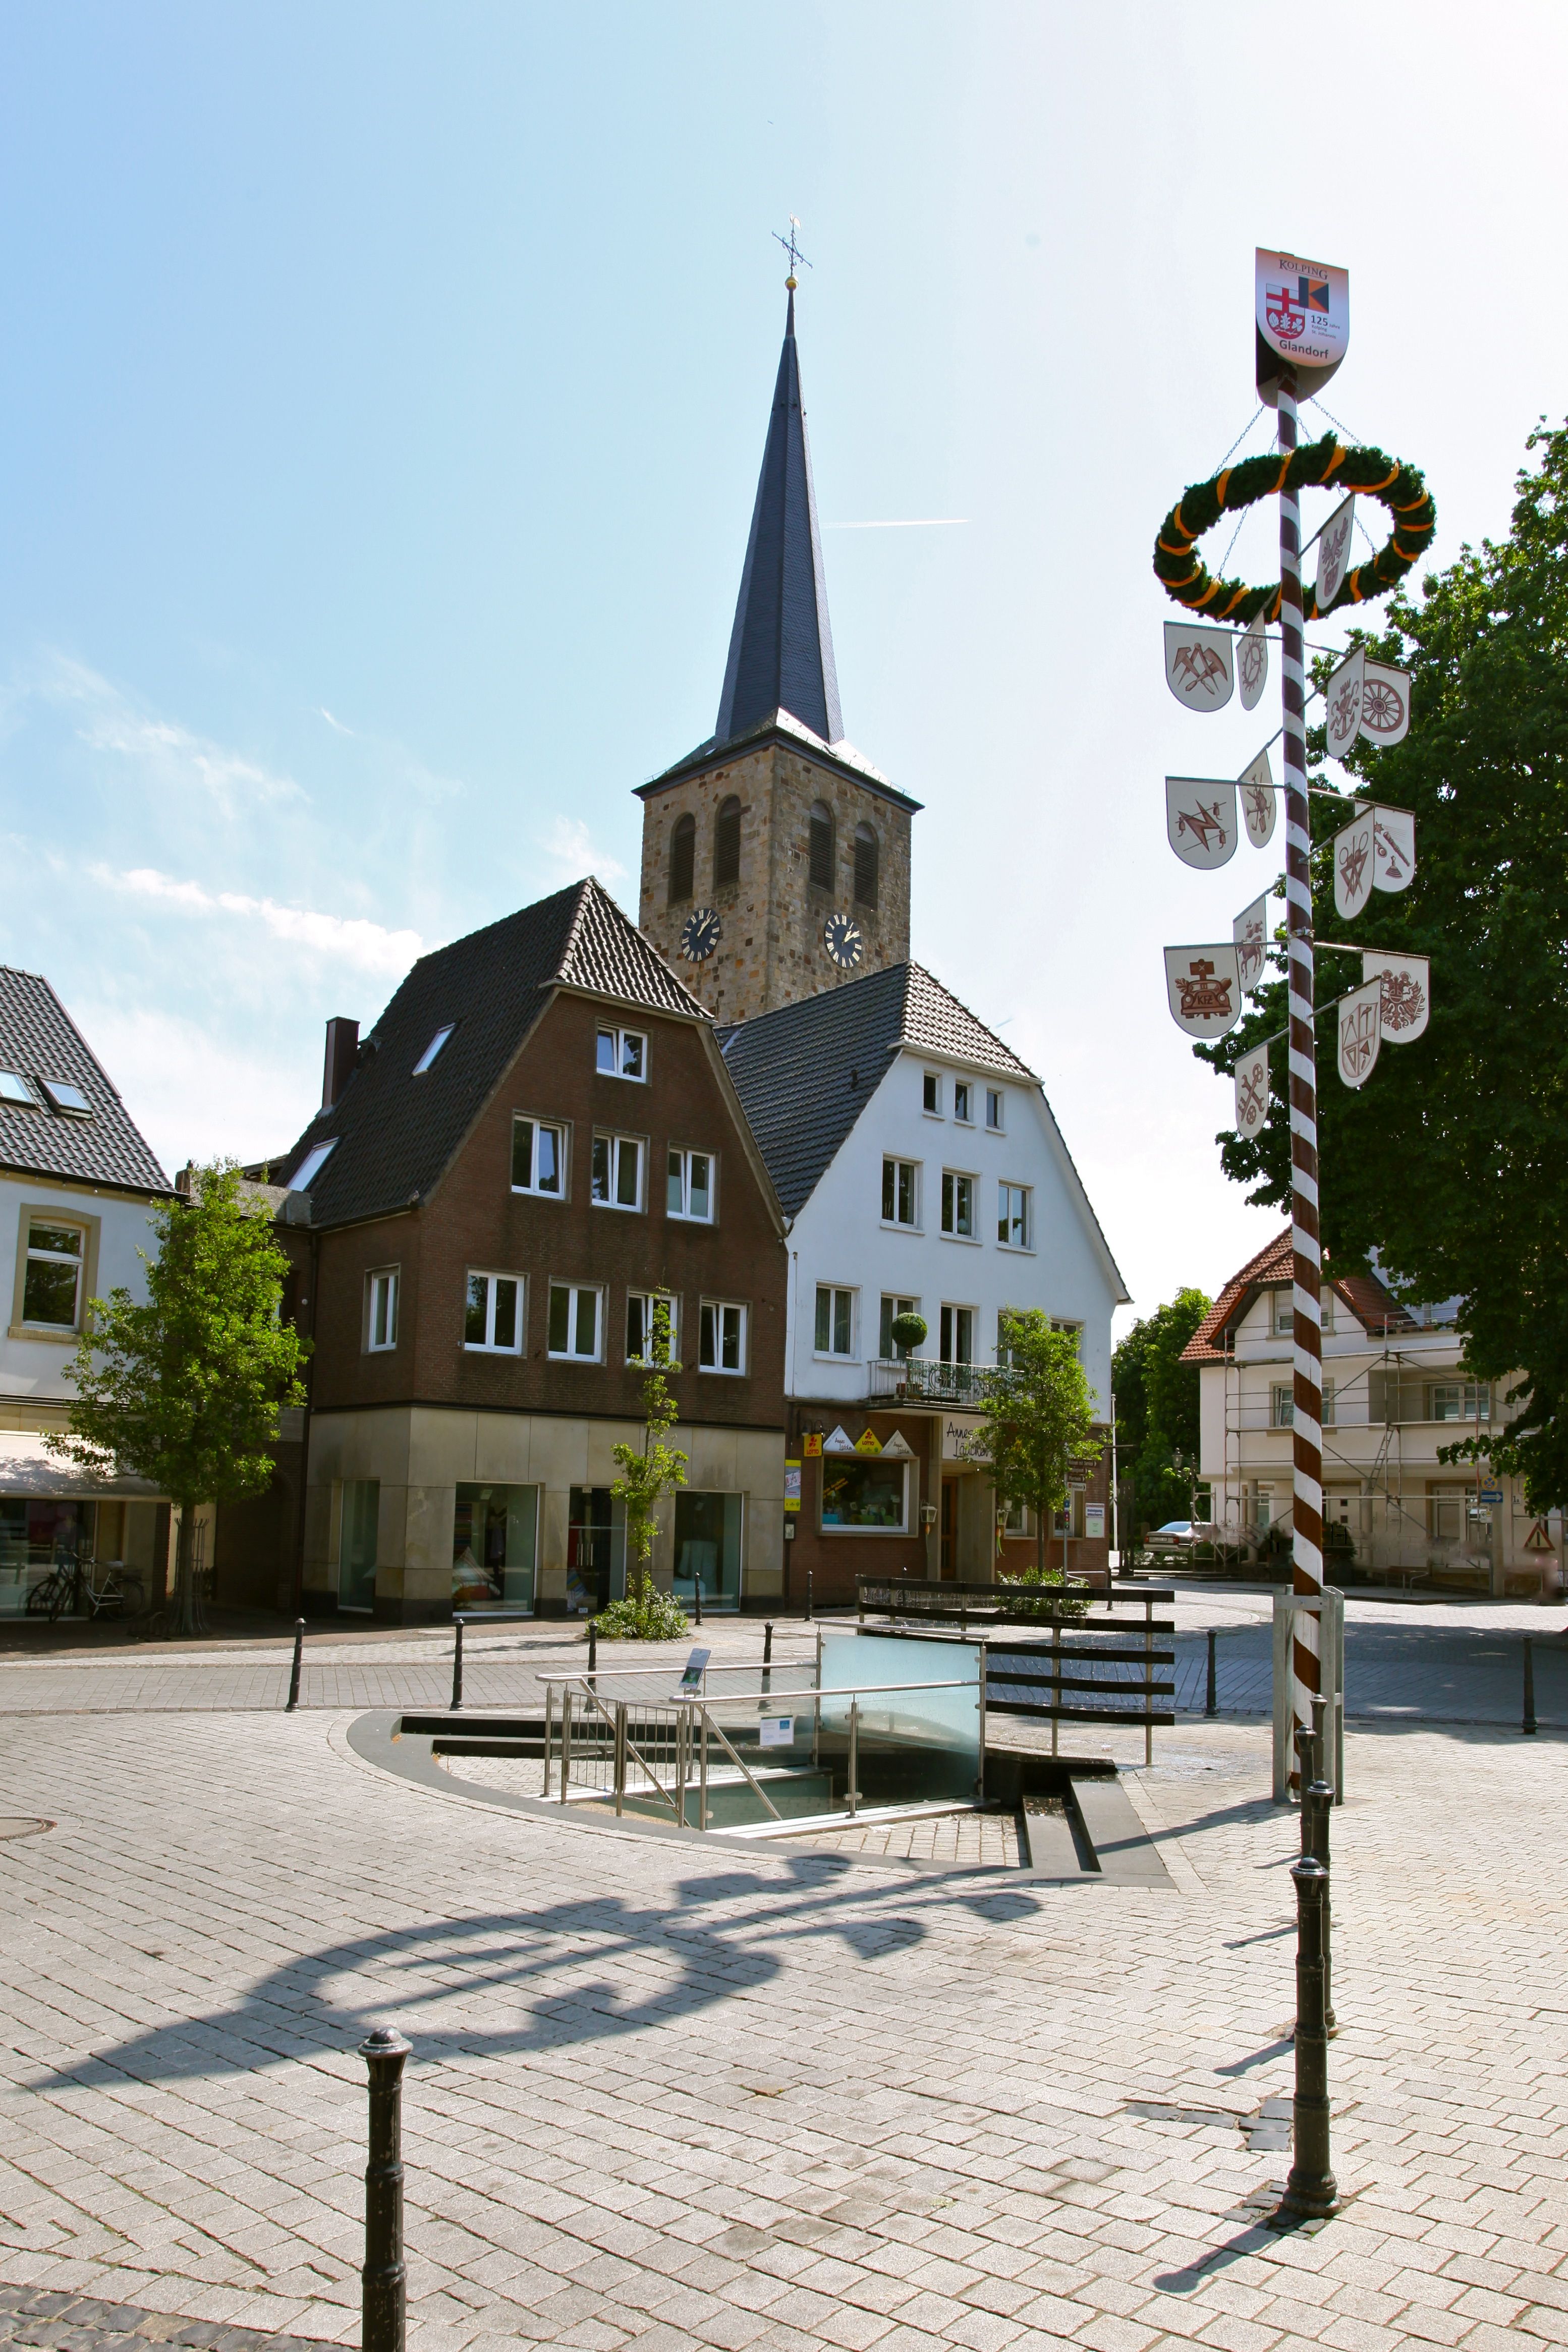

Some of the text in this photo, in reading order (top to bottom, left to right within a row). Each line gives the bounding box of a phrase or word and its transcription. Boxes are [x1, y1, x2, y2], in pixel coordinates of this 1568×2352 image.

[1279, 259, 1328, 281] KOLPING
[1311, 315, 1328, 327] 125
[1312, 324, 1327, 332] Kolping
[1279, 340, 1329, 359] Glandorf
[1198, 995, 1213, 1004] KFZ
[946, 1421, 974, 1439] Annes
